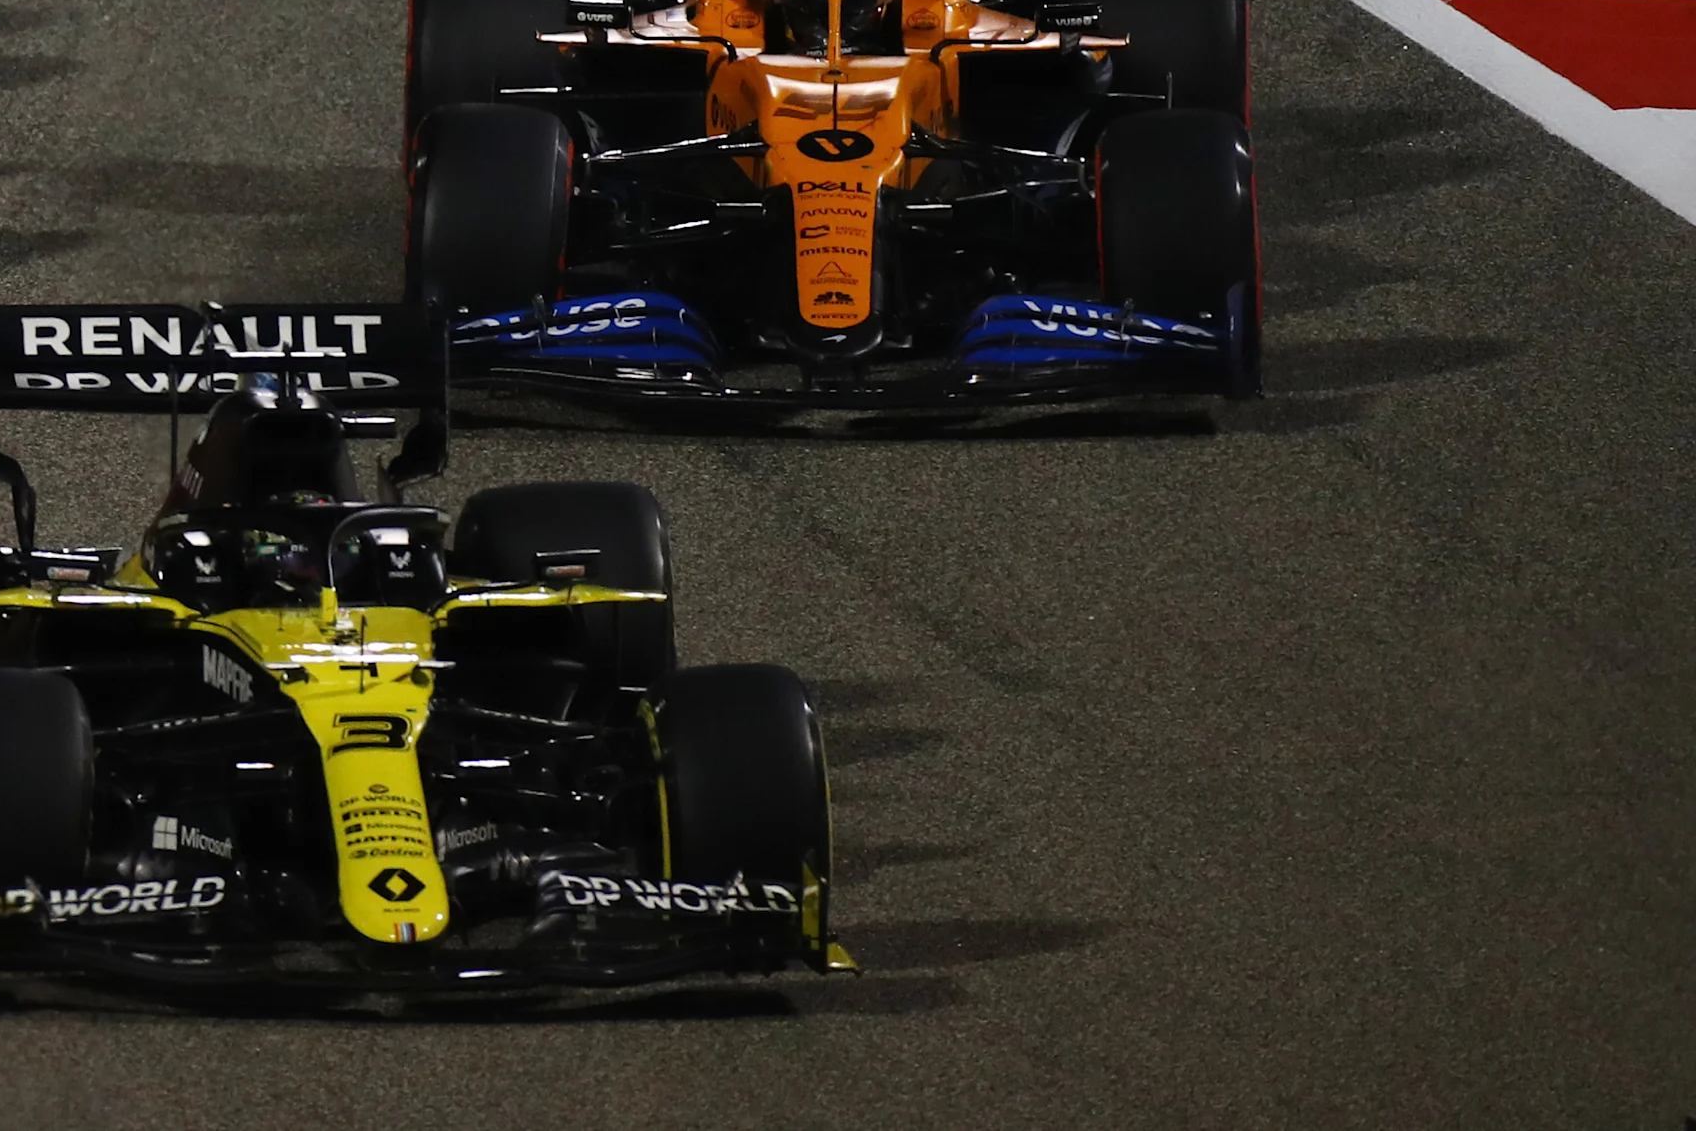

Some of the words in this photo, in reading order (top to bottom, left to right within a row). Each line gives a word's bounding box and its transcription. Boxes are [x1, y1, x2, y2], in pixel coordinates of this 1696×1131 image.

[797, 181, 872, 195] DELL
[20, 315, 382, 356] RENAULT
[13, 372, 112, 390] DP
[124, 372, 401, 393] WOLD
[326, 713, 412, 761] 3
[363, 795, 422, 807] WORLD
[181, 824, 234, 859] Microsoft
[446, 821, 499, 850] Microsoft
[49, 876, 226, 917] WORLD
[558, 873, 622, 906] DP
[624, 878, 800, 913] WORLD
